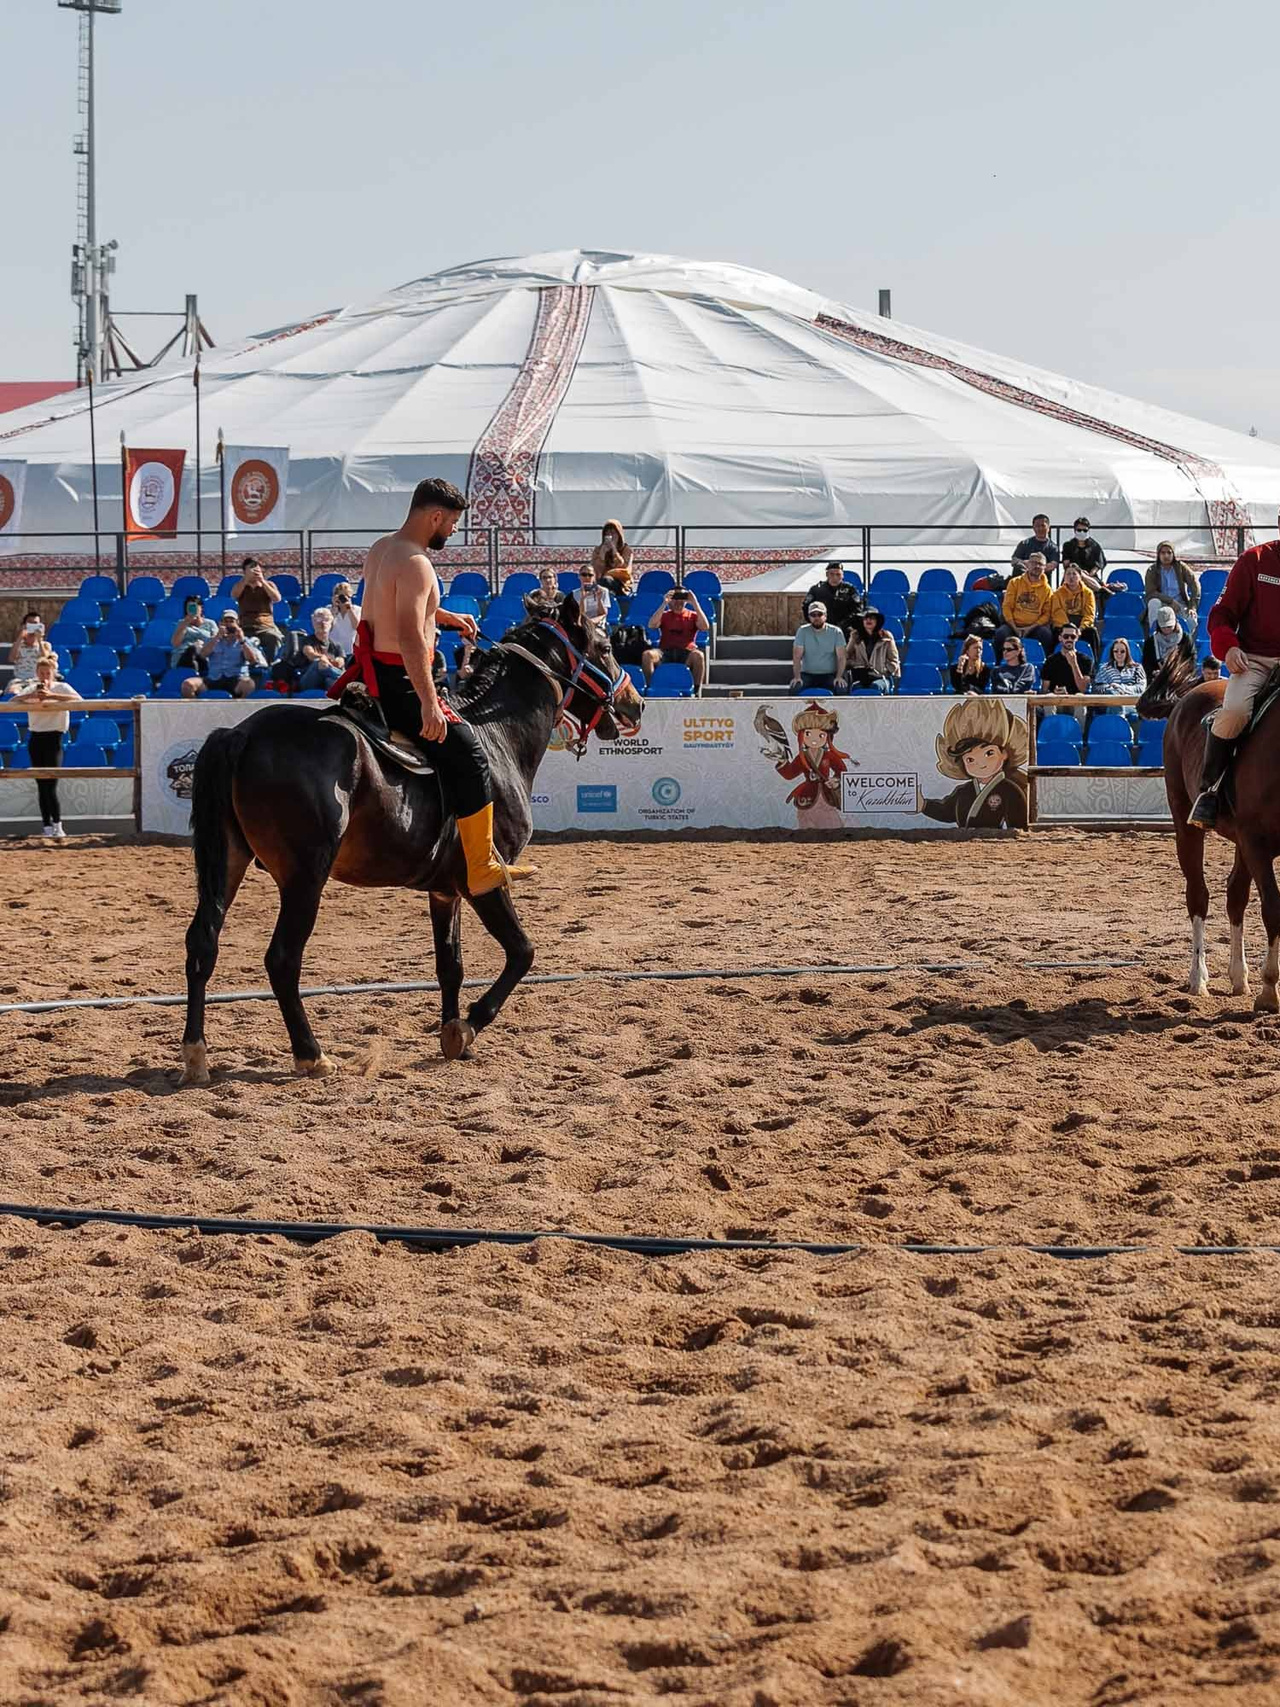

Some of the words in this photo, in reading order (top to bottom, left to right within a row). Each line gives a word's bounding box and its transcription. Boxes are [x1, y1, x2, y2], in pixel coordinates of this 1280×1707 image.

[683, 717, 735, 728] ULTTYQ
[683, 730, 735, 741] SPORT
[613, 738, 649, 747] WORLD
[599, 747, 663, 755] ETHNOSPORT
[846, 777, 915, 788] WELCOME
[531, 795, 550, 803] SCO
